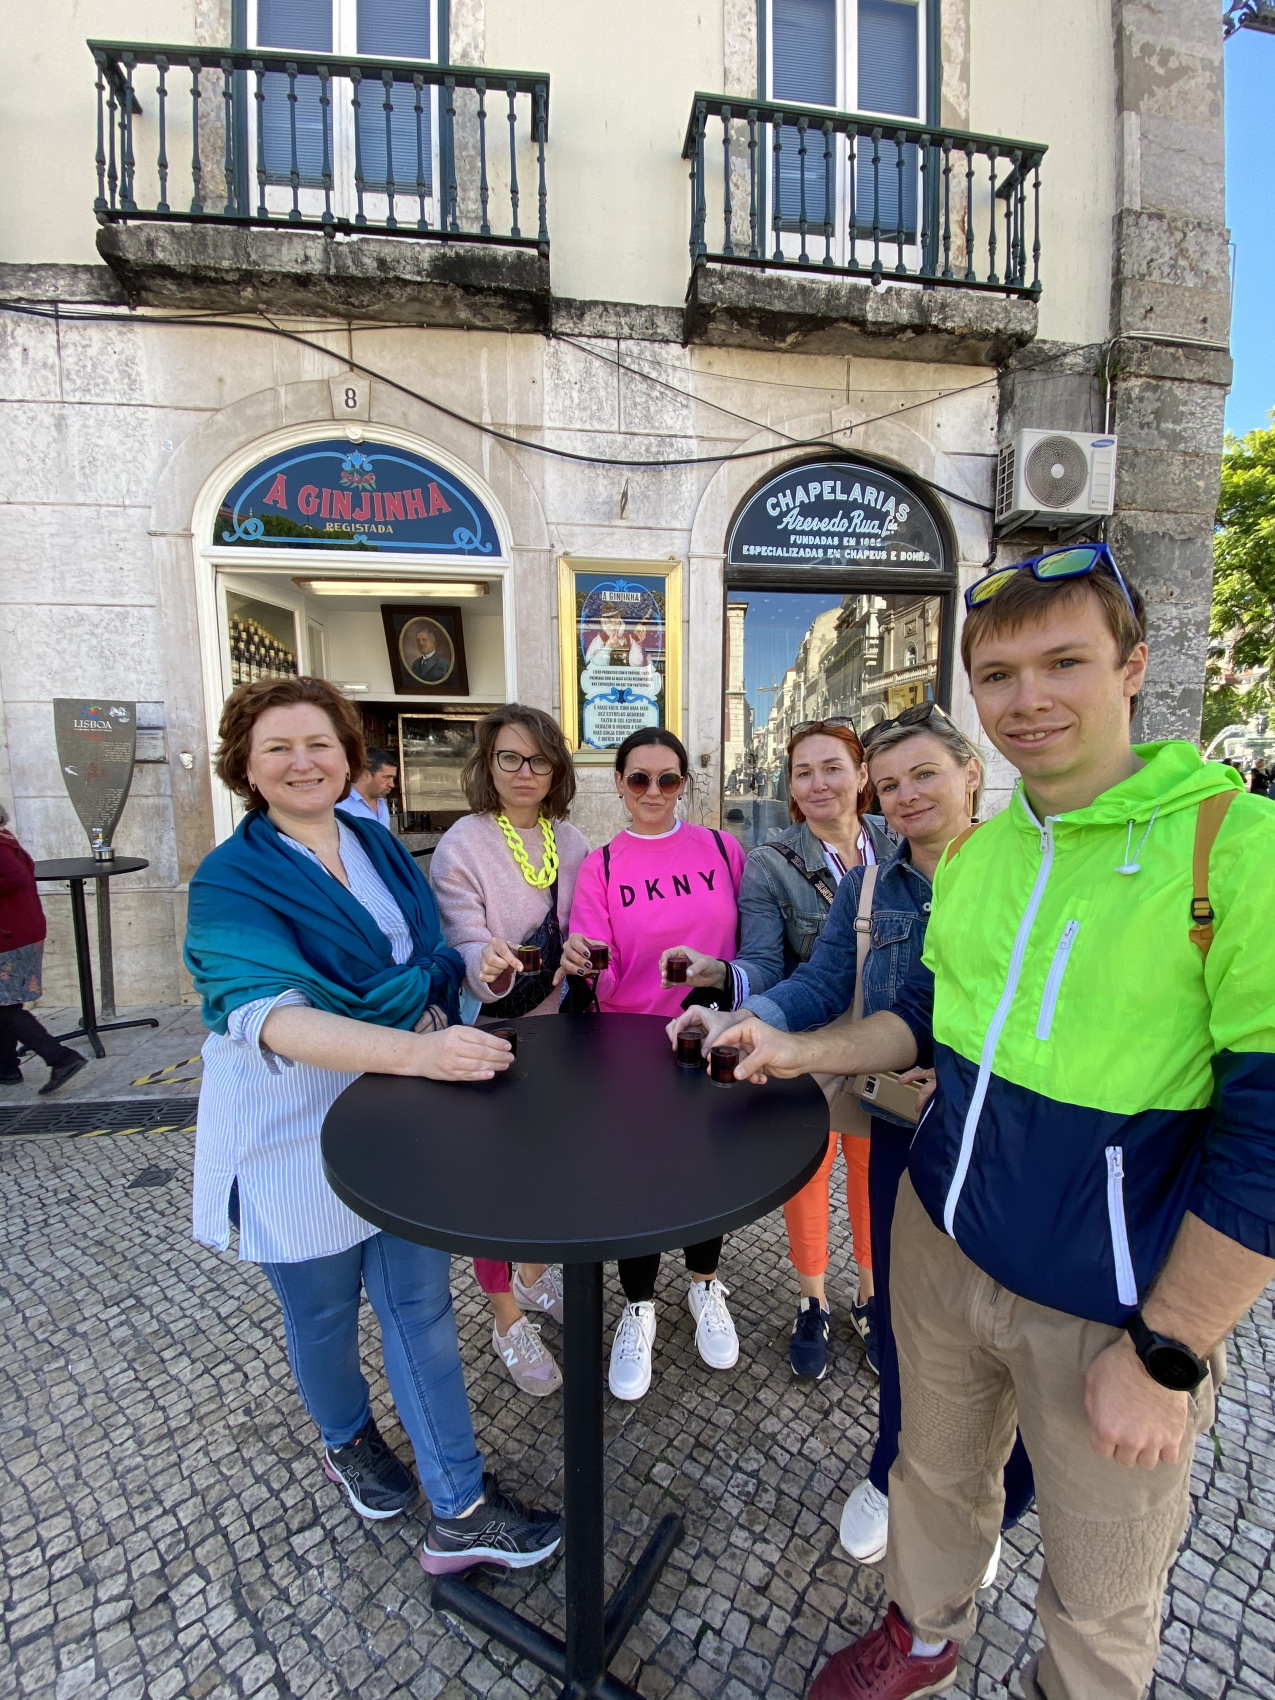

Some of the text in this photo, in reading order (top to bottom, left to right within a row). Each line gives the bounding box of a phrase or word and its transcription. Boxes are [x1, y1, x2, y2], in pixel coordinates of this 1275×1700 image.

[344, 387, 358, 409] 8
[263, 473, 452, 522] A GINJINHA
[766, 480, 910, 522] CHAPELARIAS
[325, 521, 394, 534] REGISTADA
[790, 534, 839, 546] FUNDADAS
[843, 537, 856, 546] EM
[742, 545, 824, 558] ESPECIALIZADAS
[827, 548, 840, 558] EM
[890, 550, 897, 560] E
[610, 592, 640, 602] GINJINHA
[74, 719, 112, 729] LISBOA
[619, 869, 716, 908] DKNY
[536, 1292, 556, 1310] N
[502, 1346, 519, 1368] N
